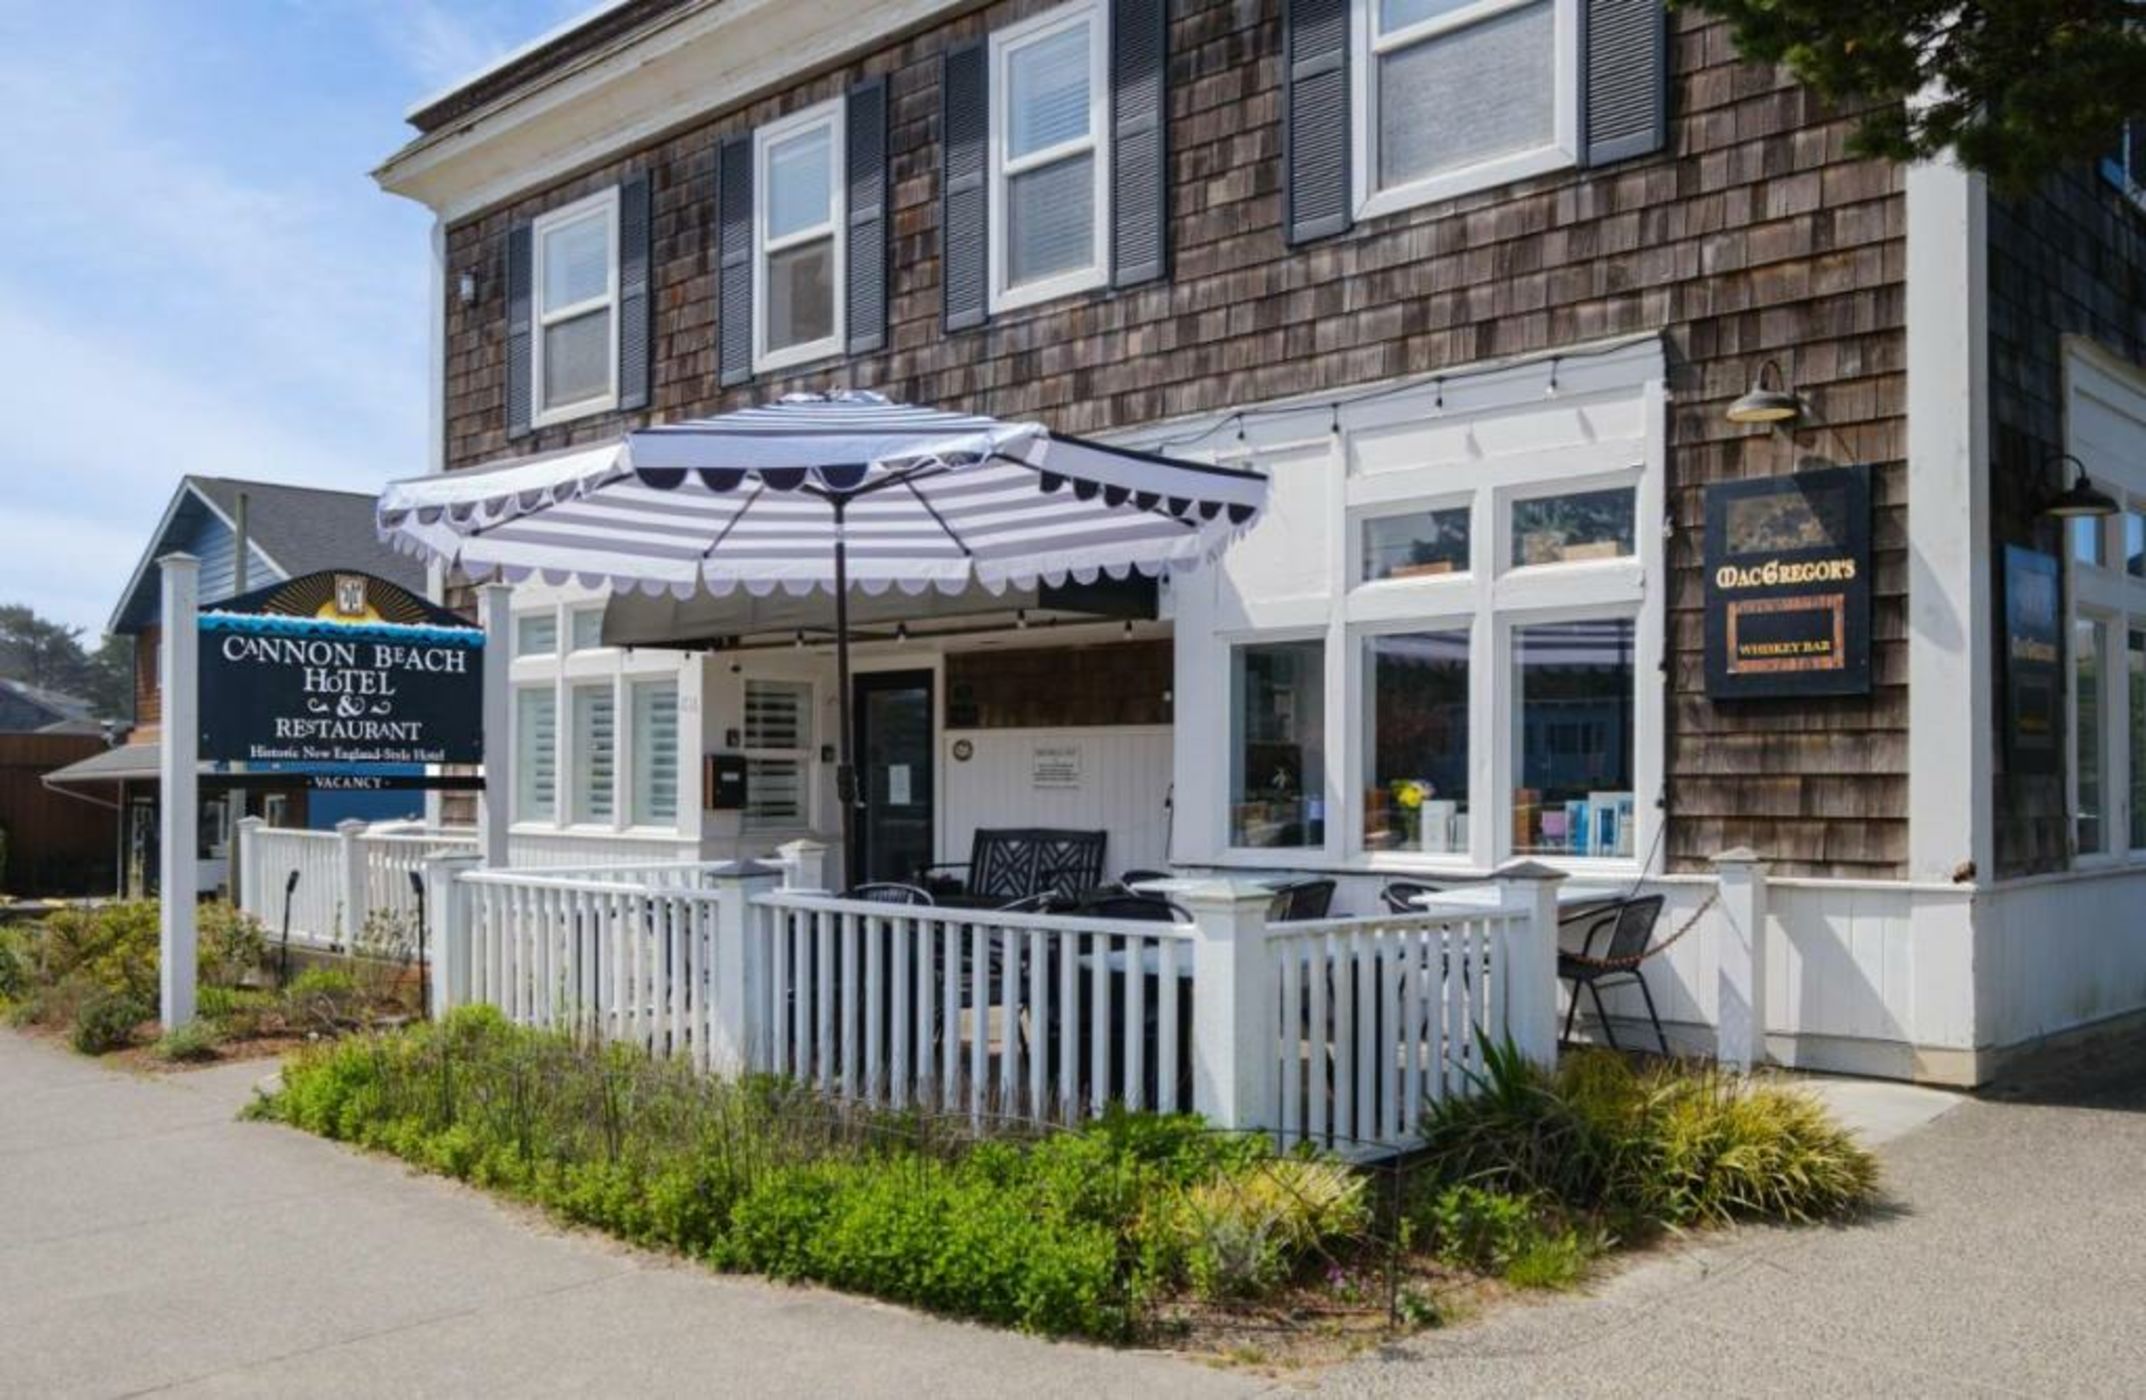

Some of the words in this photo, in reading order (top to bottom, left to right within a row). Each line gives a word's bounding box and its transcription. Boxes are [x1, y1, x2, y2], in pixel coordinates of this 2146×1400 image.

[222, 635, 356, 667] CANNON
[374, 644, 466, 673] BEACH
[1740, 642, 1799, 656] WHISKEY
[1803, 640, 1830, 654] BAR
[336, 695, 366, 717] &
[275, 718, 422, 741] RESTAURANT
[250, 745, 299, 759] Historic
[303, 745, 331, 759] New
[334, 747, 411, 763] England-Style
[414, 748, 445, 761] Hotel
[315, 776, 382, 789] VACANCY
